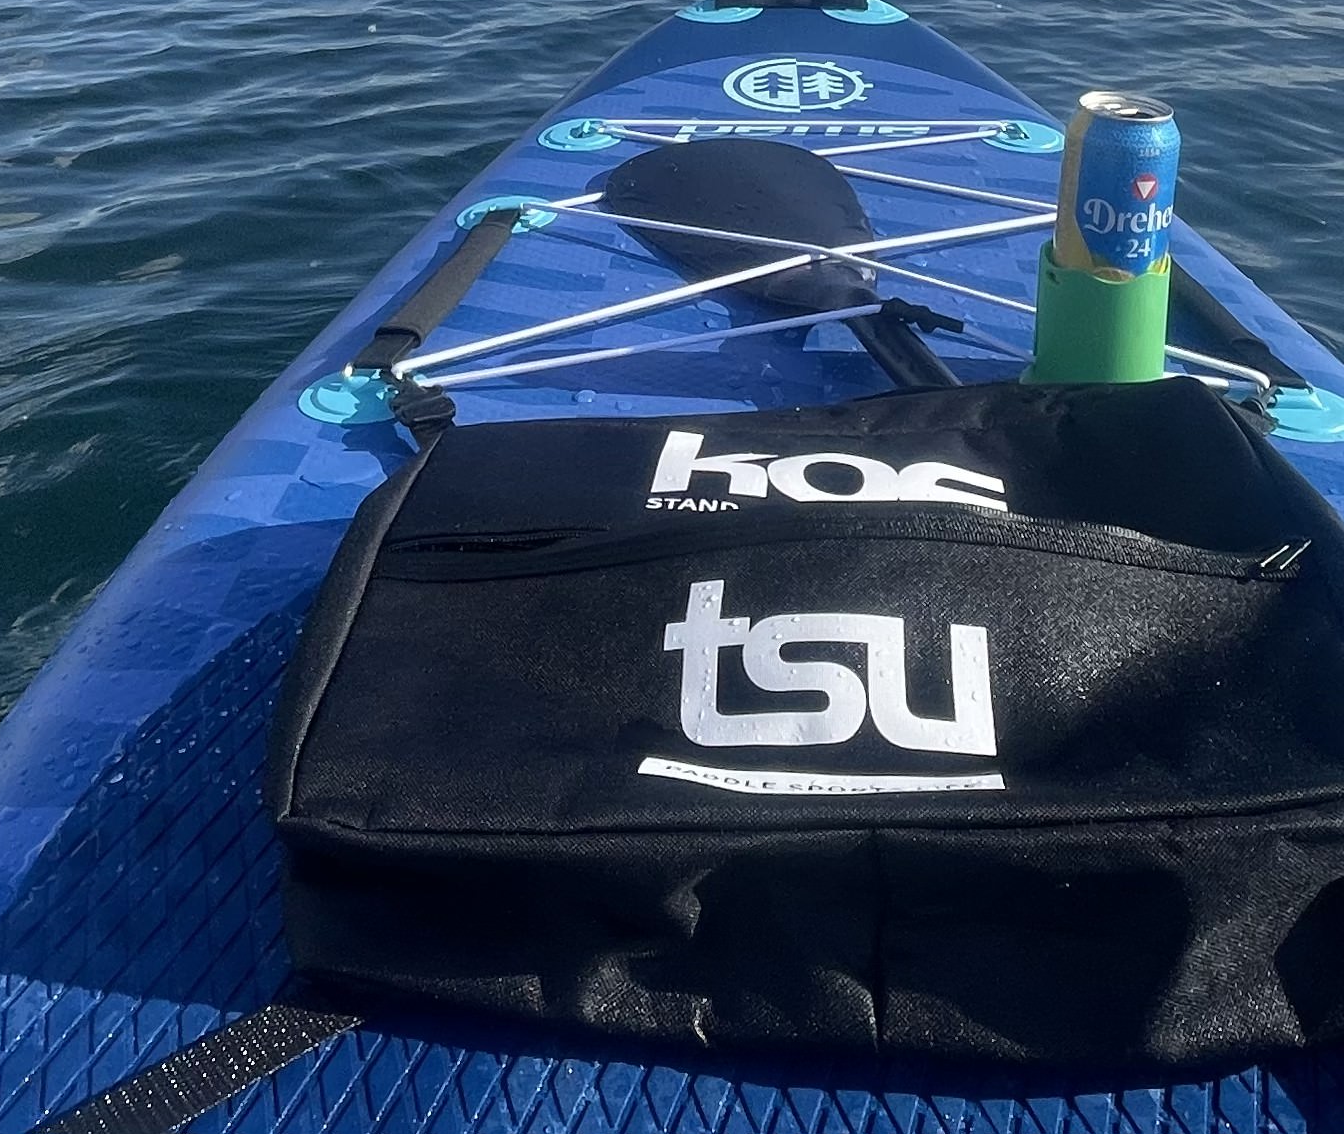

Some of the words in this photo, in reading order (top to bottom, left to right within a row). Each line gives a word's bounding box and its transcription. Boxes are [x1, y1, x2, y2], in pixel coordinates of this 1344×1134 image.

[1083, 198, 1174, 235] Drehe
[1126, 238, 1152, 259] 24
[663, 579, 998, 757] tsu
[665, 764, 777, 790] PADDLE
